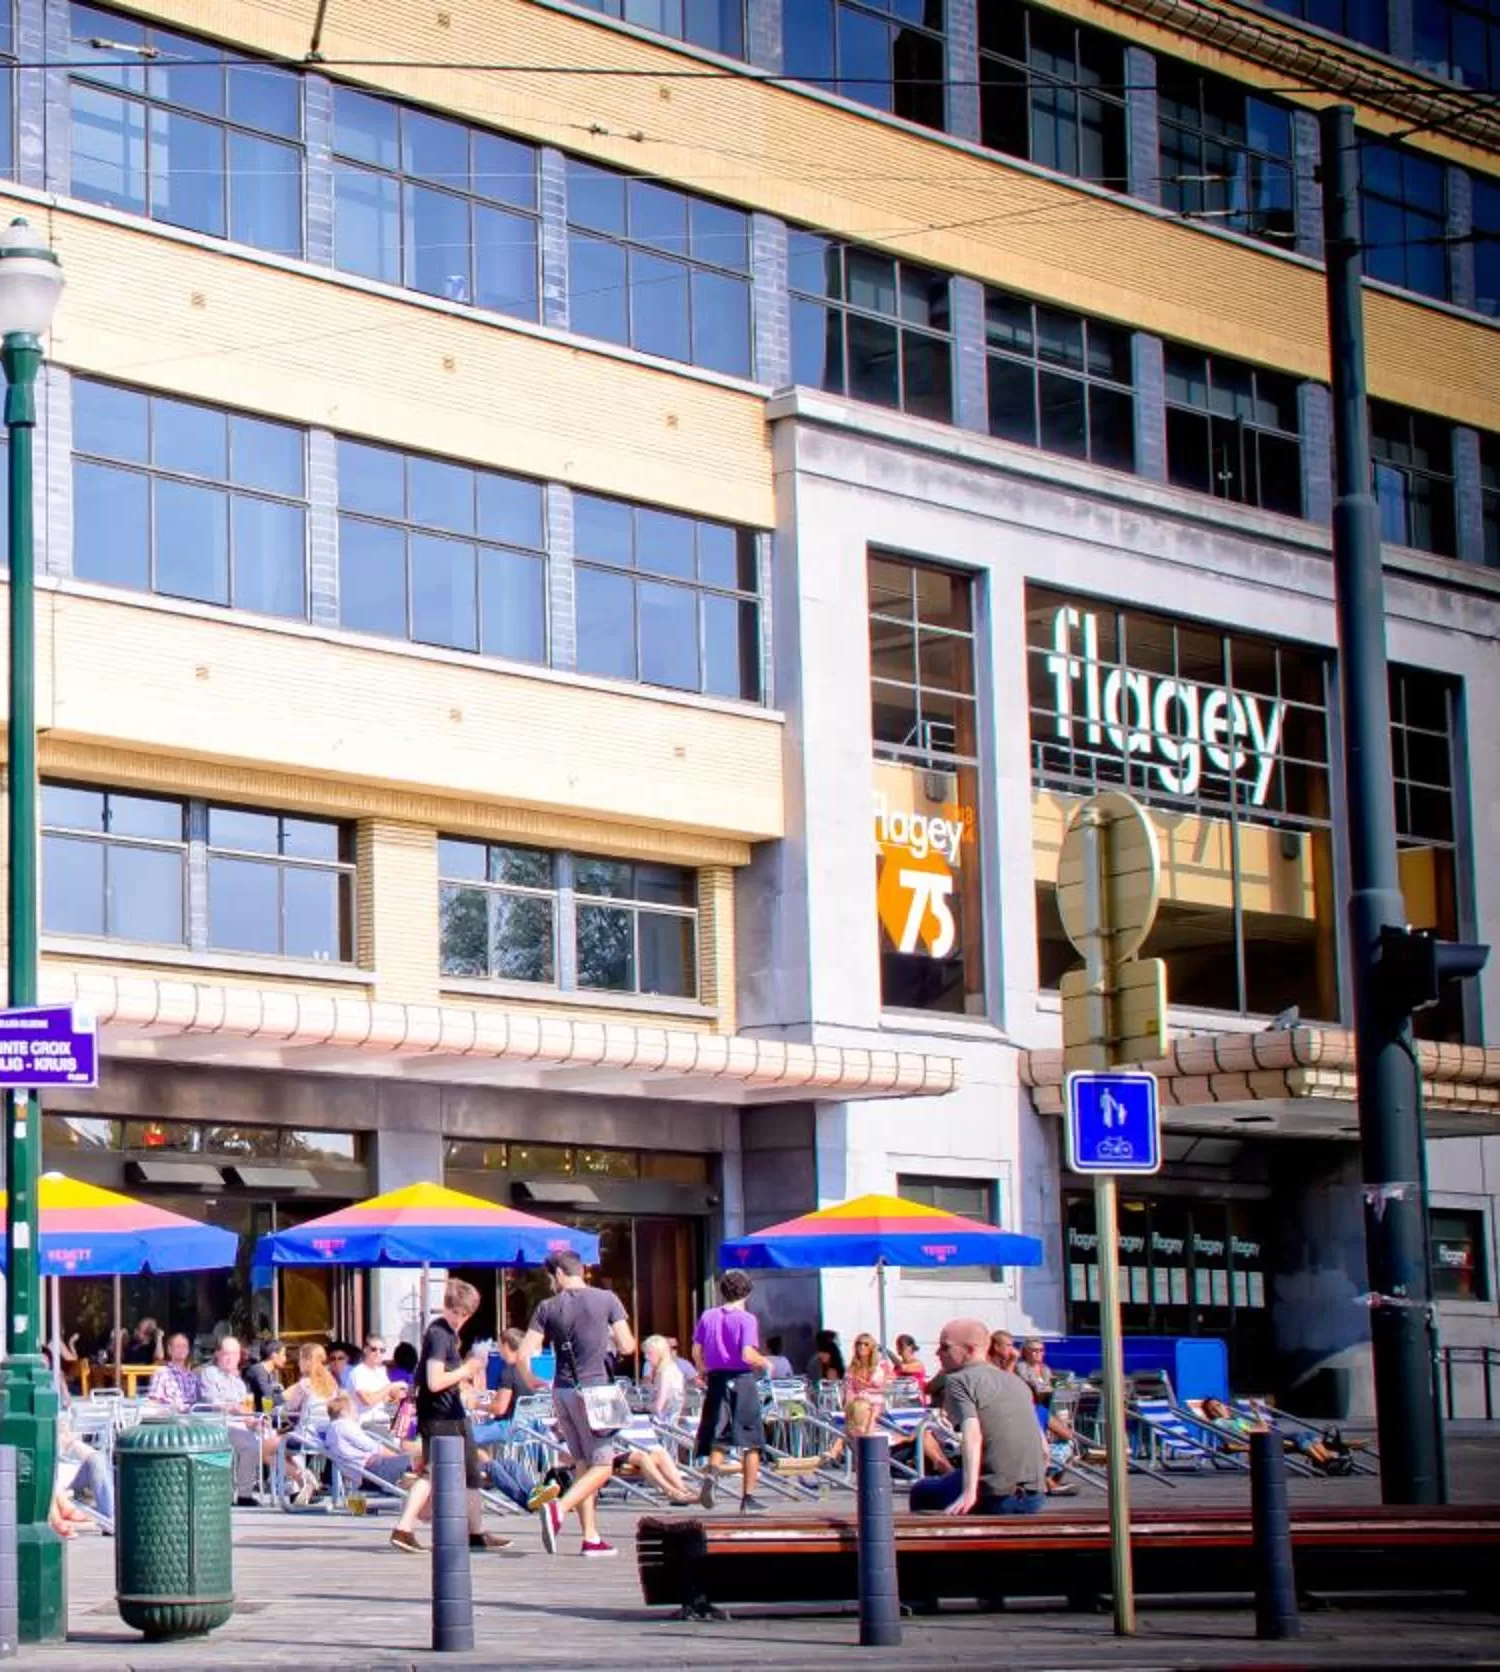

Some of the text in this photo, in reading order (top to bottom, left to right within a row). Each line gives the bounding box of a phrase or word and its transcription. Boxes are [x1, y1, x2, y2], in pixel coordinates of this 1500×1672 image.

[1047, 606, 1286, 805] flagey
[899, 869, 955, 958] 75
[30, 1041, 71, 1055] CROIX
[34, 1057, 76, 1071] KRUIS
